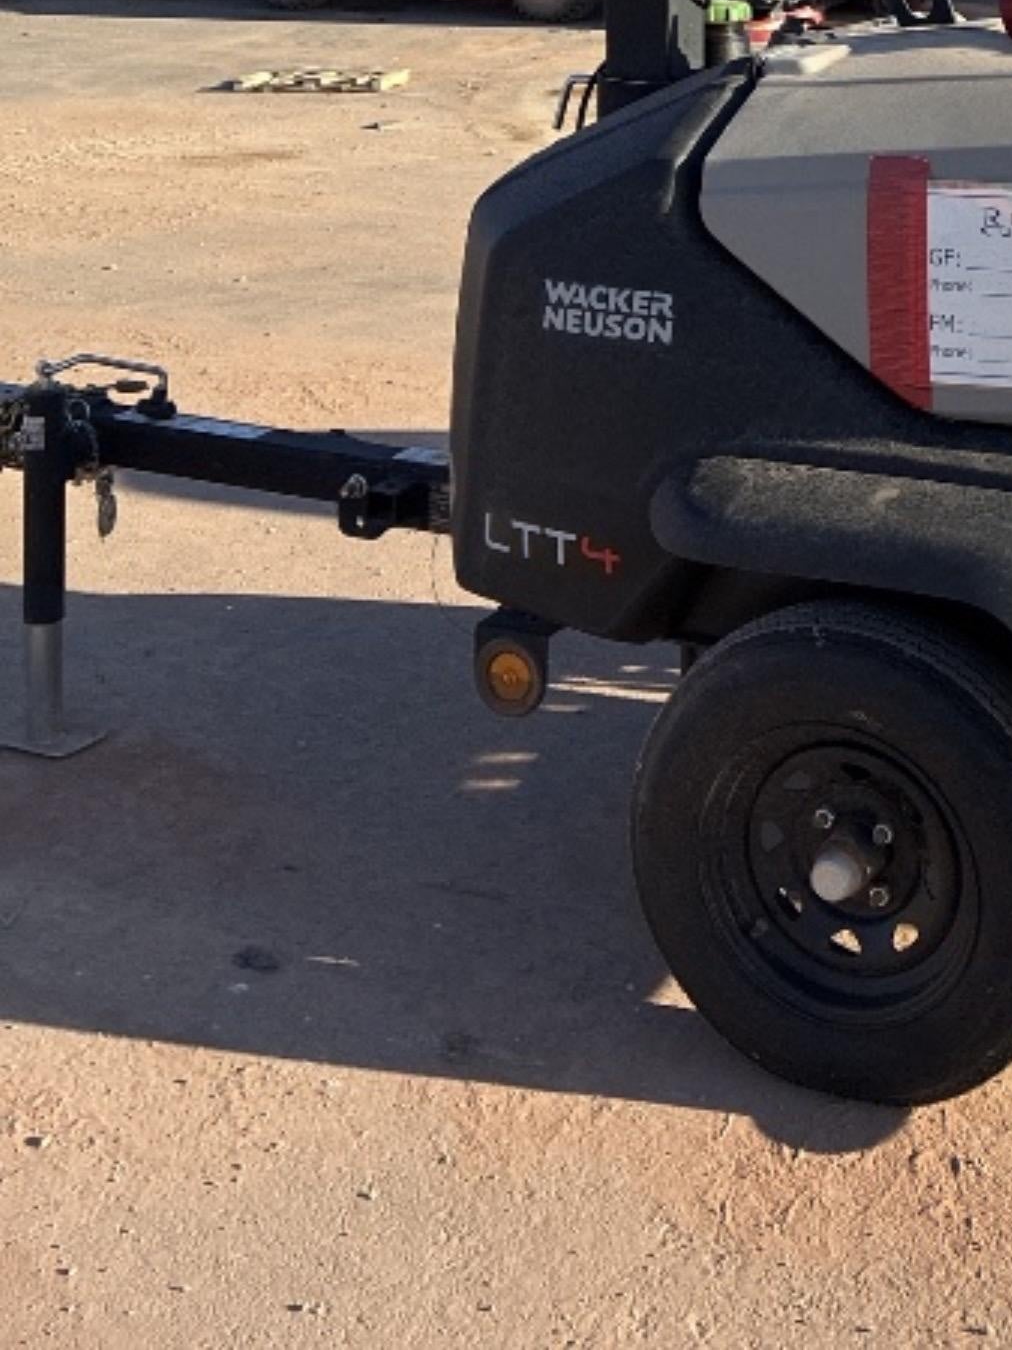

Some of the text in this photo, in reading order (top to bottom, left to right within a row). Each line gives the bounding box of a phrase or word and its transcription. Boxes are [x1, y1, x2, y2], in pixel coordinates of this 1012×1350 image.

[929, 248, 961, 268] GF:
[544, 278, 675, 319] WACKER
[542, 304, 674, 346] NEUSON
[929, 314, 964, 334] FM:
